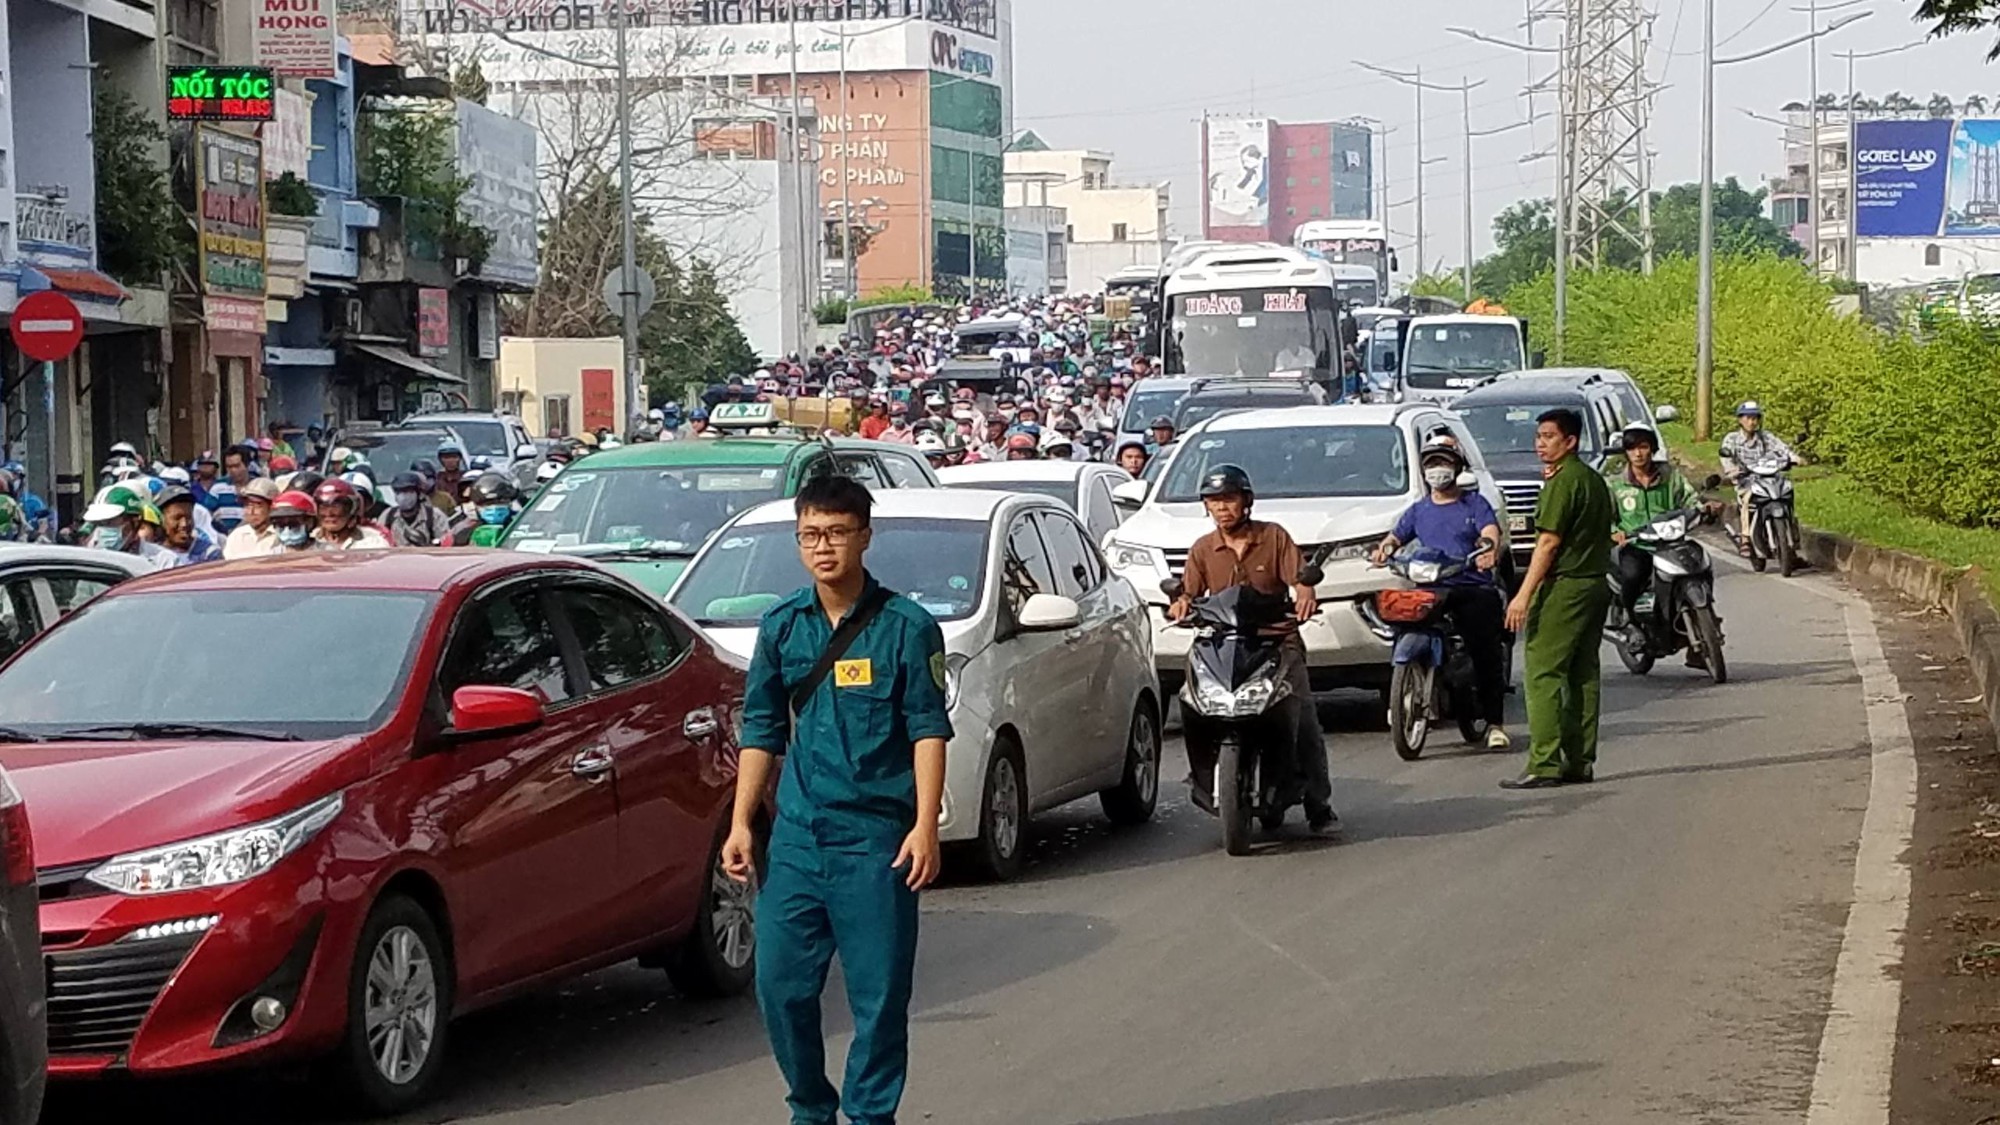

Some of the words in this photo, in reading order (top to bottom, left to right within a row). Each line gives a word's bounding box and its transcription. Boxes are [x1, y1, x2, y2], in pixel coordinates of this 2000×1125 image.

[258, 15, 327, 31] HỌNG
[931, 29, 957, 69] OPC
[172, 69, 215, 97] NỐI
[220, 72, 269, 98] TÓC
[859, 113, 887, 131] TY
[1857, 150, 1900, 163] GOTEC
[1901, 149, 1937, 164] LAND
[717, 404, 768, 418] TAXI
